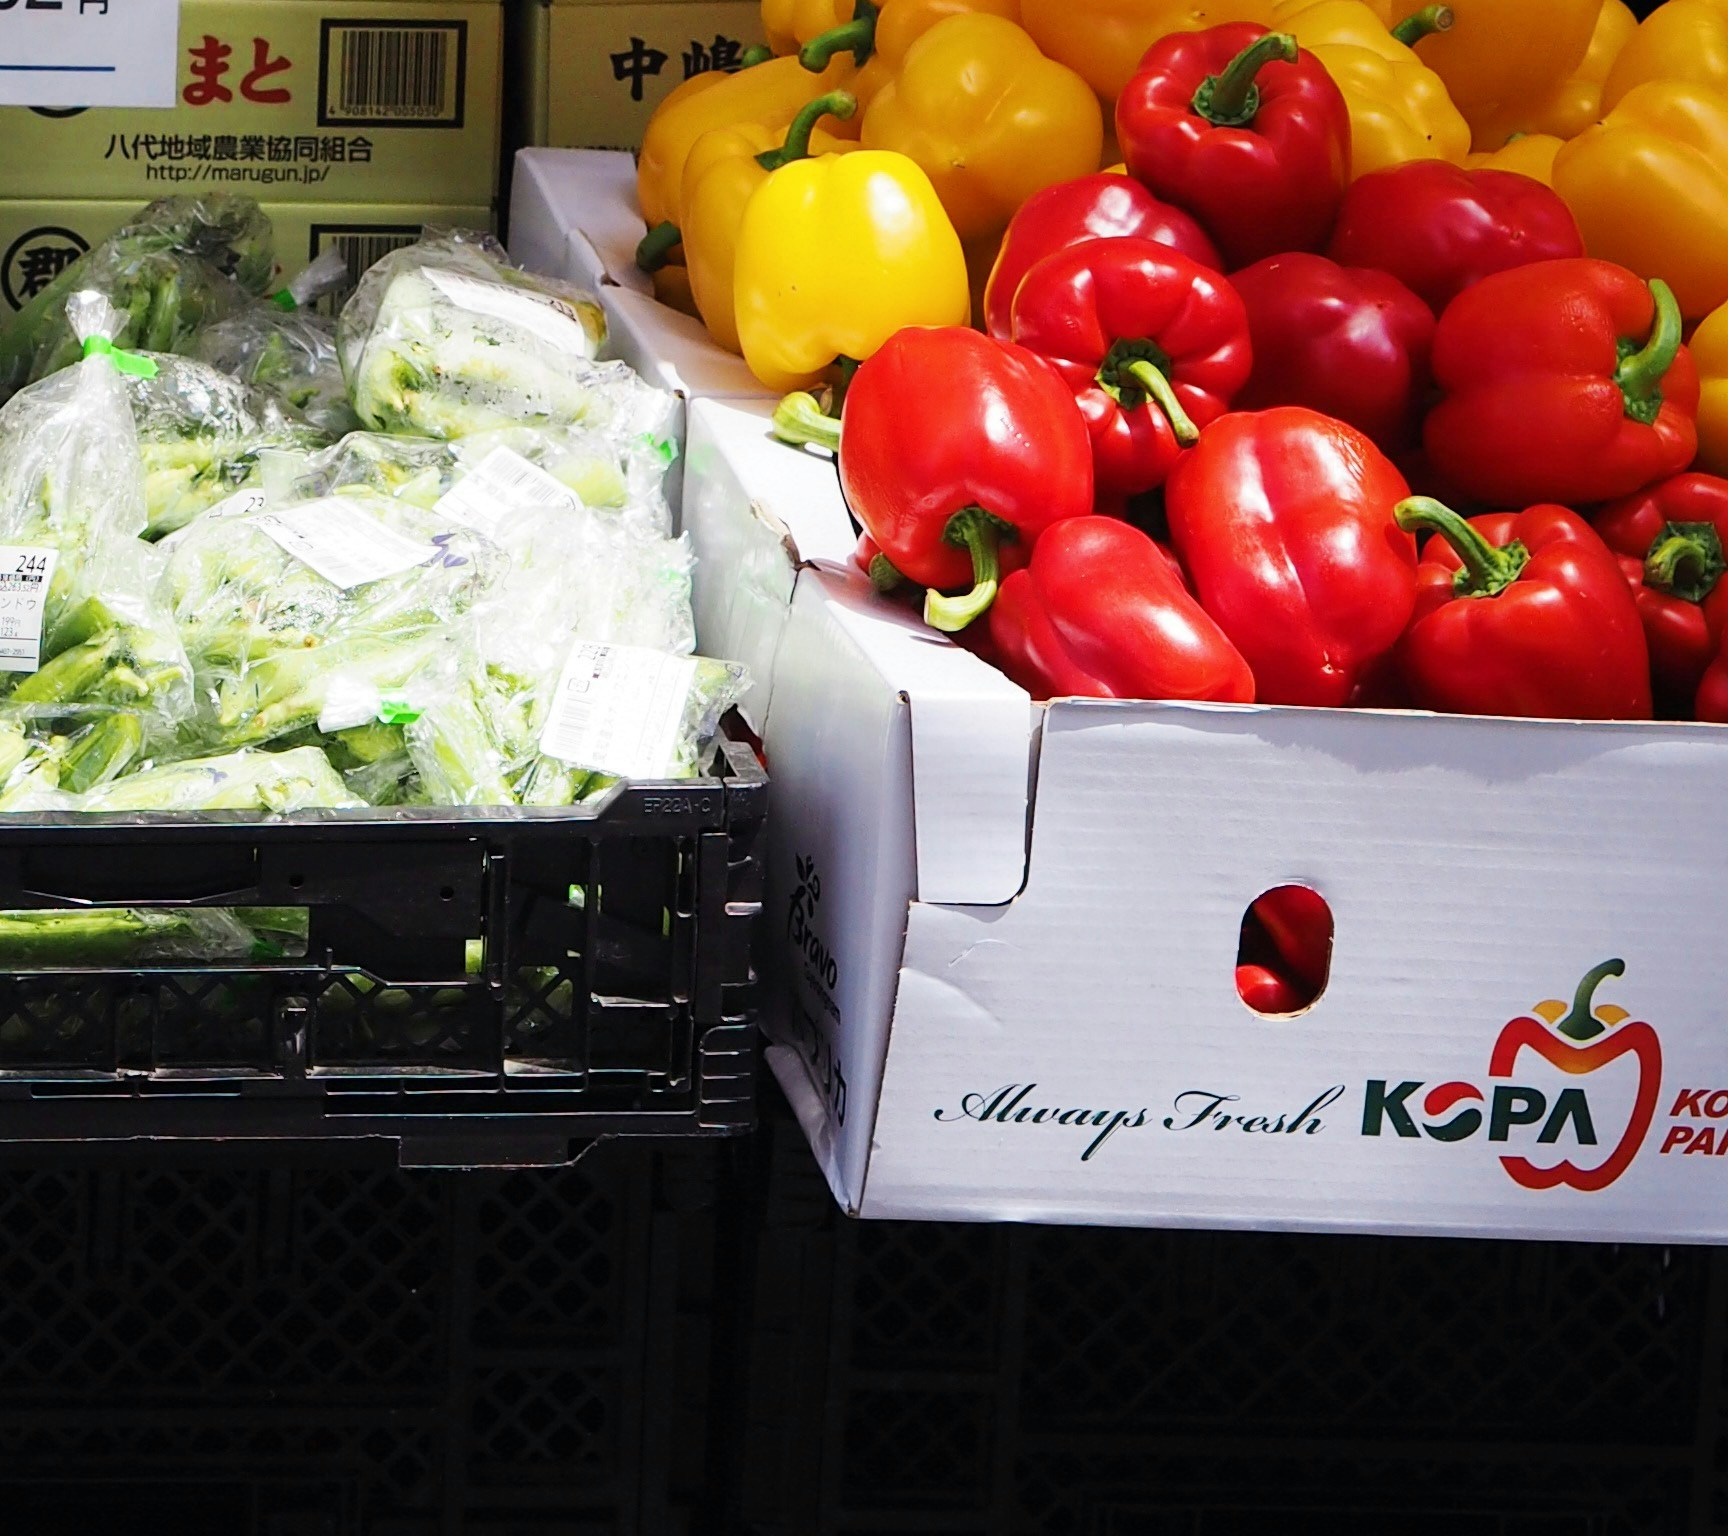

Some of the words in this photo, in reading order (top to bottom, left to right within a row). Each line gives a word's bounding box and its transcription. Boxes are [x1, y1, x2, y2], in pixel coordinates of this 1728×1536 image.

[104, 132, 374, 164] 八代地域農業協同組合
[146, 163, 332, 184] http://marugun.jp/
[15, 554, 48, 574] 244
[933, 1080, 1154, 1162] Always
[1162, 1083, 1349, 1137] Fresh
